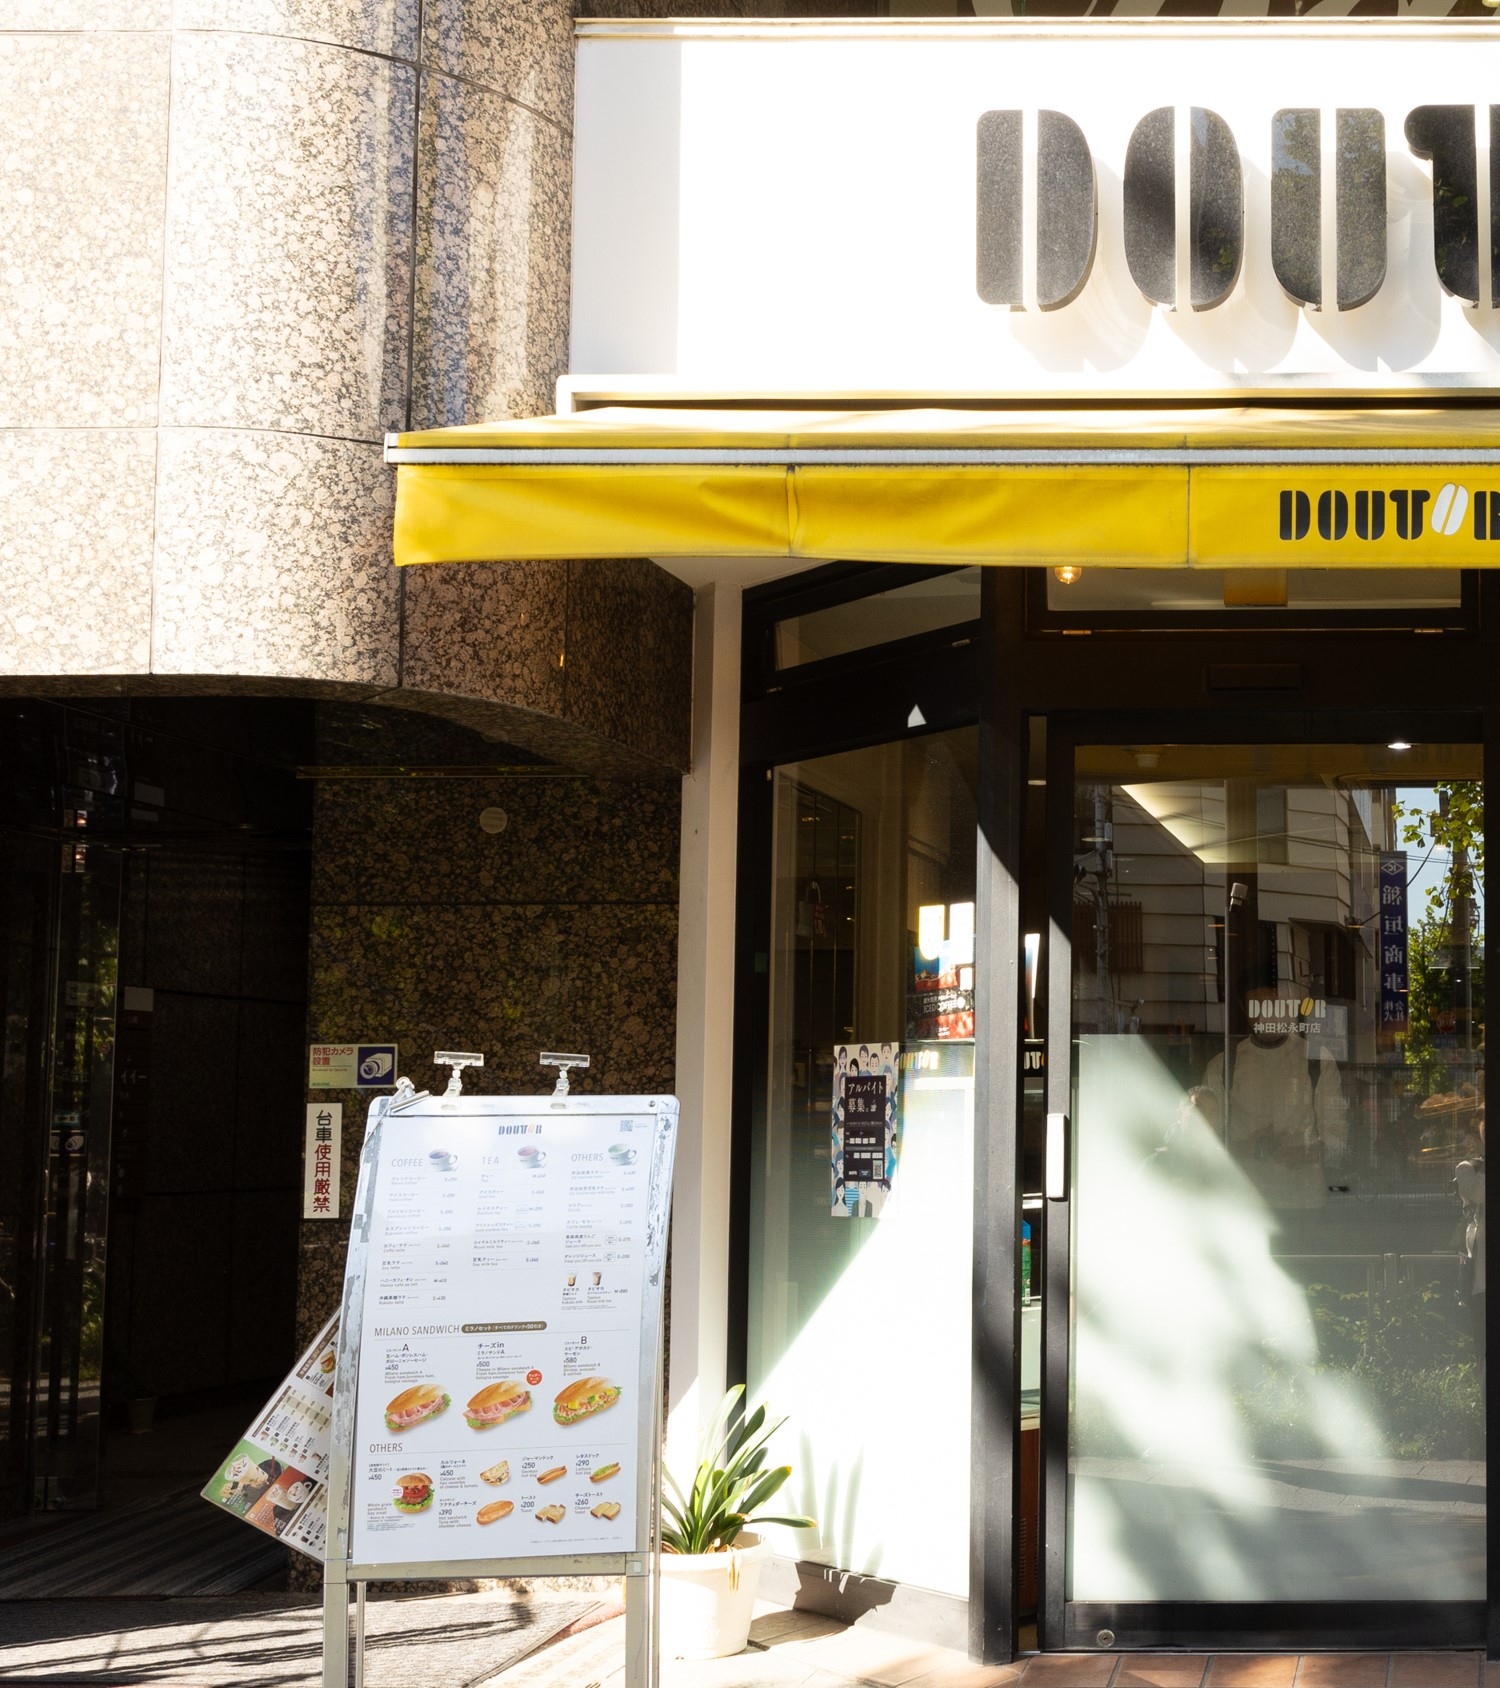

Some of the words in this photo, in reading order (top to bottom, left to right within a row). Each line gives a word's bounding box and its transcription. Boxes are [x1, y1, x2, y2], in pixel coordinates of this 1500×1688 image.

[1248, 997, 1327, 1018] DOUTOR
[1253, 1022, 1321, 1034] 神田松永町店
[312, 1047, 354, 1056] 防犯カメラ
[312, 1056, 331, 1066] 設置
[847, 1081, 884, 1096] アルバイト
[313, 1109, 333, 1214] 台車使用厳禁
[391, 1158, 424, 1168] COFFEE
[482, 1155, 500, 1165] TEA
[571, 1153, 605, 1163] OTHERS
[374, 1327, 410, 1338] MILANO
[411, 1324, 461, 1336] SANDWICH
[581, 1336, 588, 1345] B
[369, 1442, 404, 1454] OTHERS
